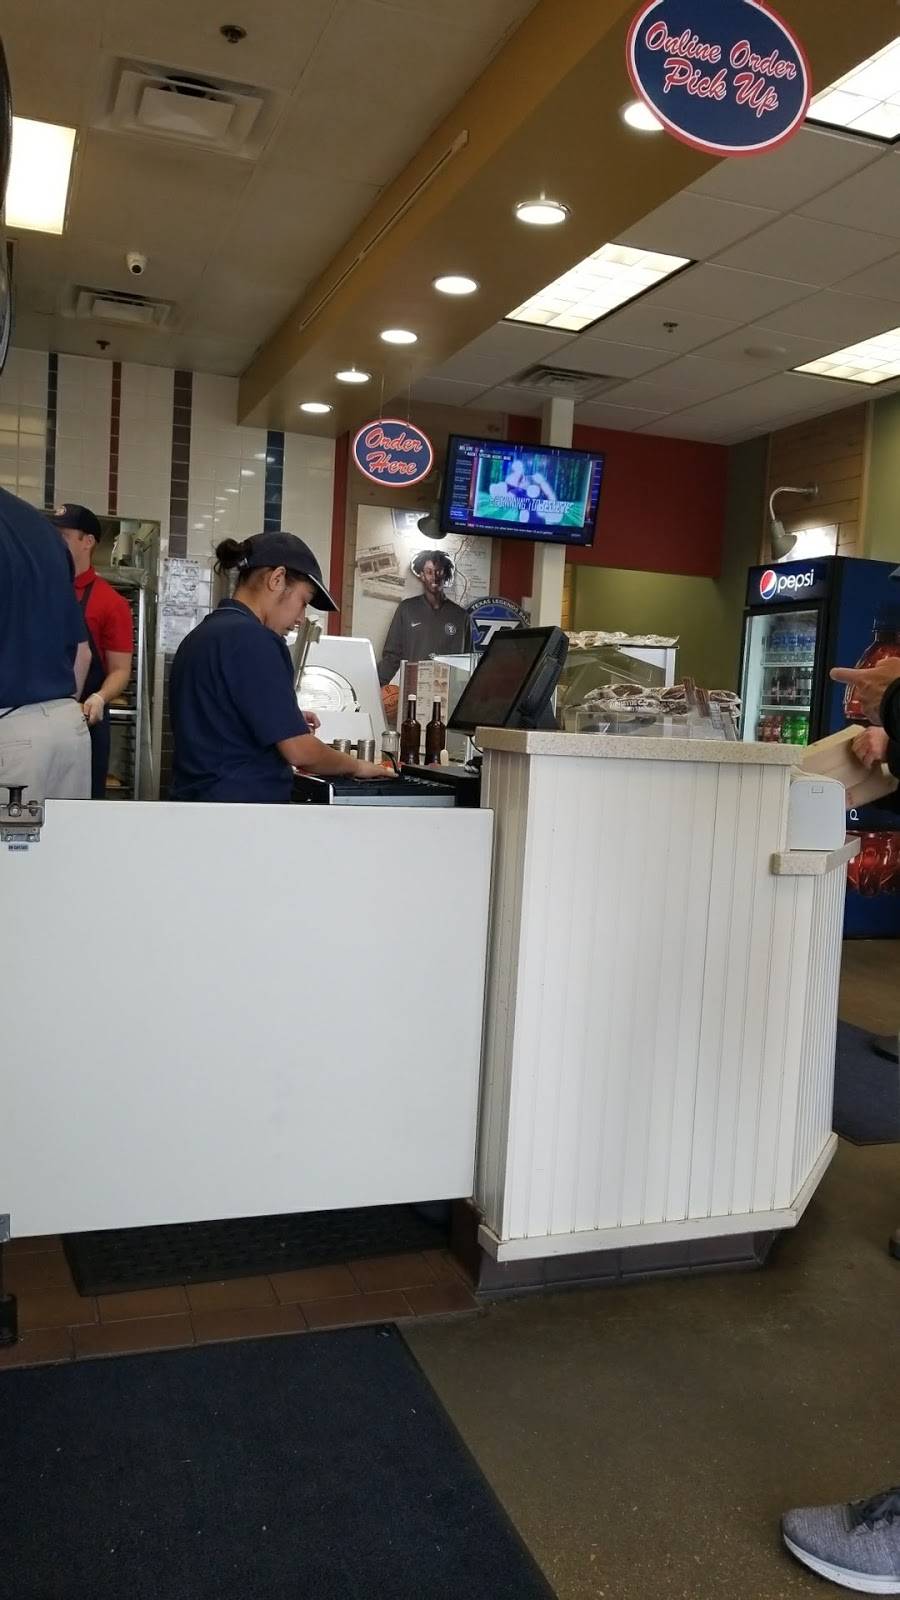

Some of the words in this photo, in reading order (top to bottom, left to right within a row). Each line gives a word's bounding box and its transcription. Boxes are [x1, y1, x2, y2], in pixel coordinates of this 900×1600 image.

[645, 21, 722, 64] Online
[729, 40, 797, 80] Order
[663, 57, 728, 100] Pick
[733, 71, 780, 118] Up
[365, 427, 423, 452] Order
[366, 451, 417, 475] Here
[776, 569, 815, 593] pepsi
[471, 599, 491, 610] TEXAS
